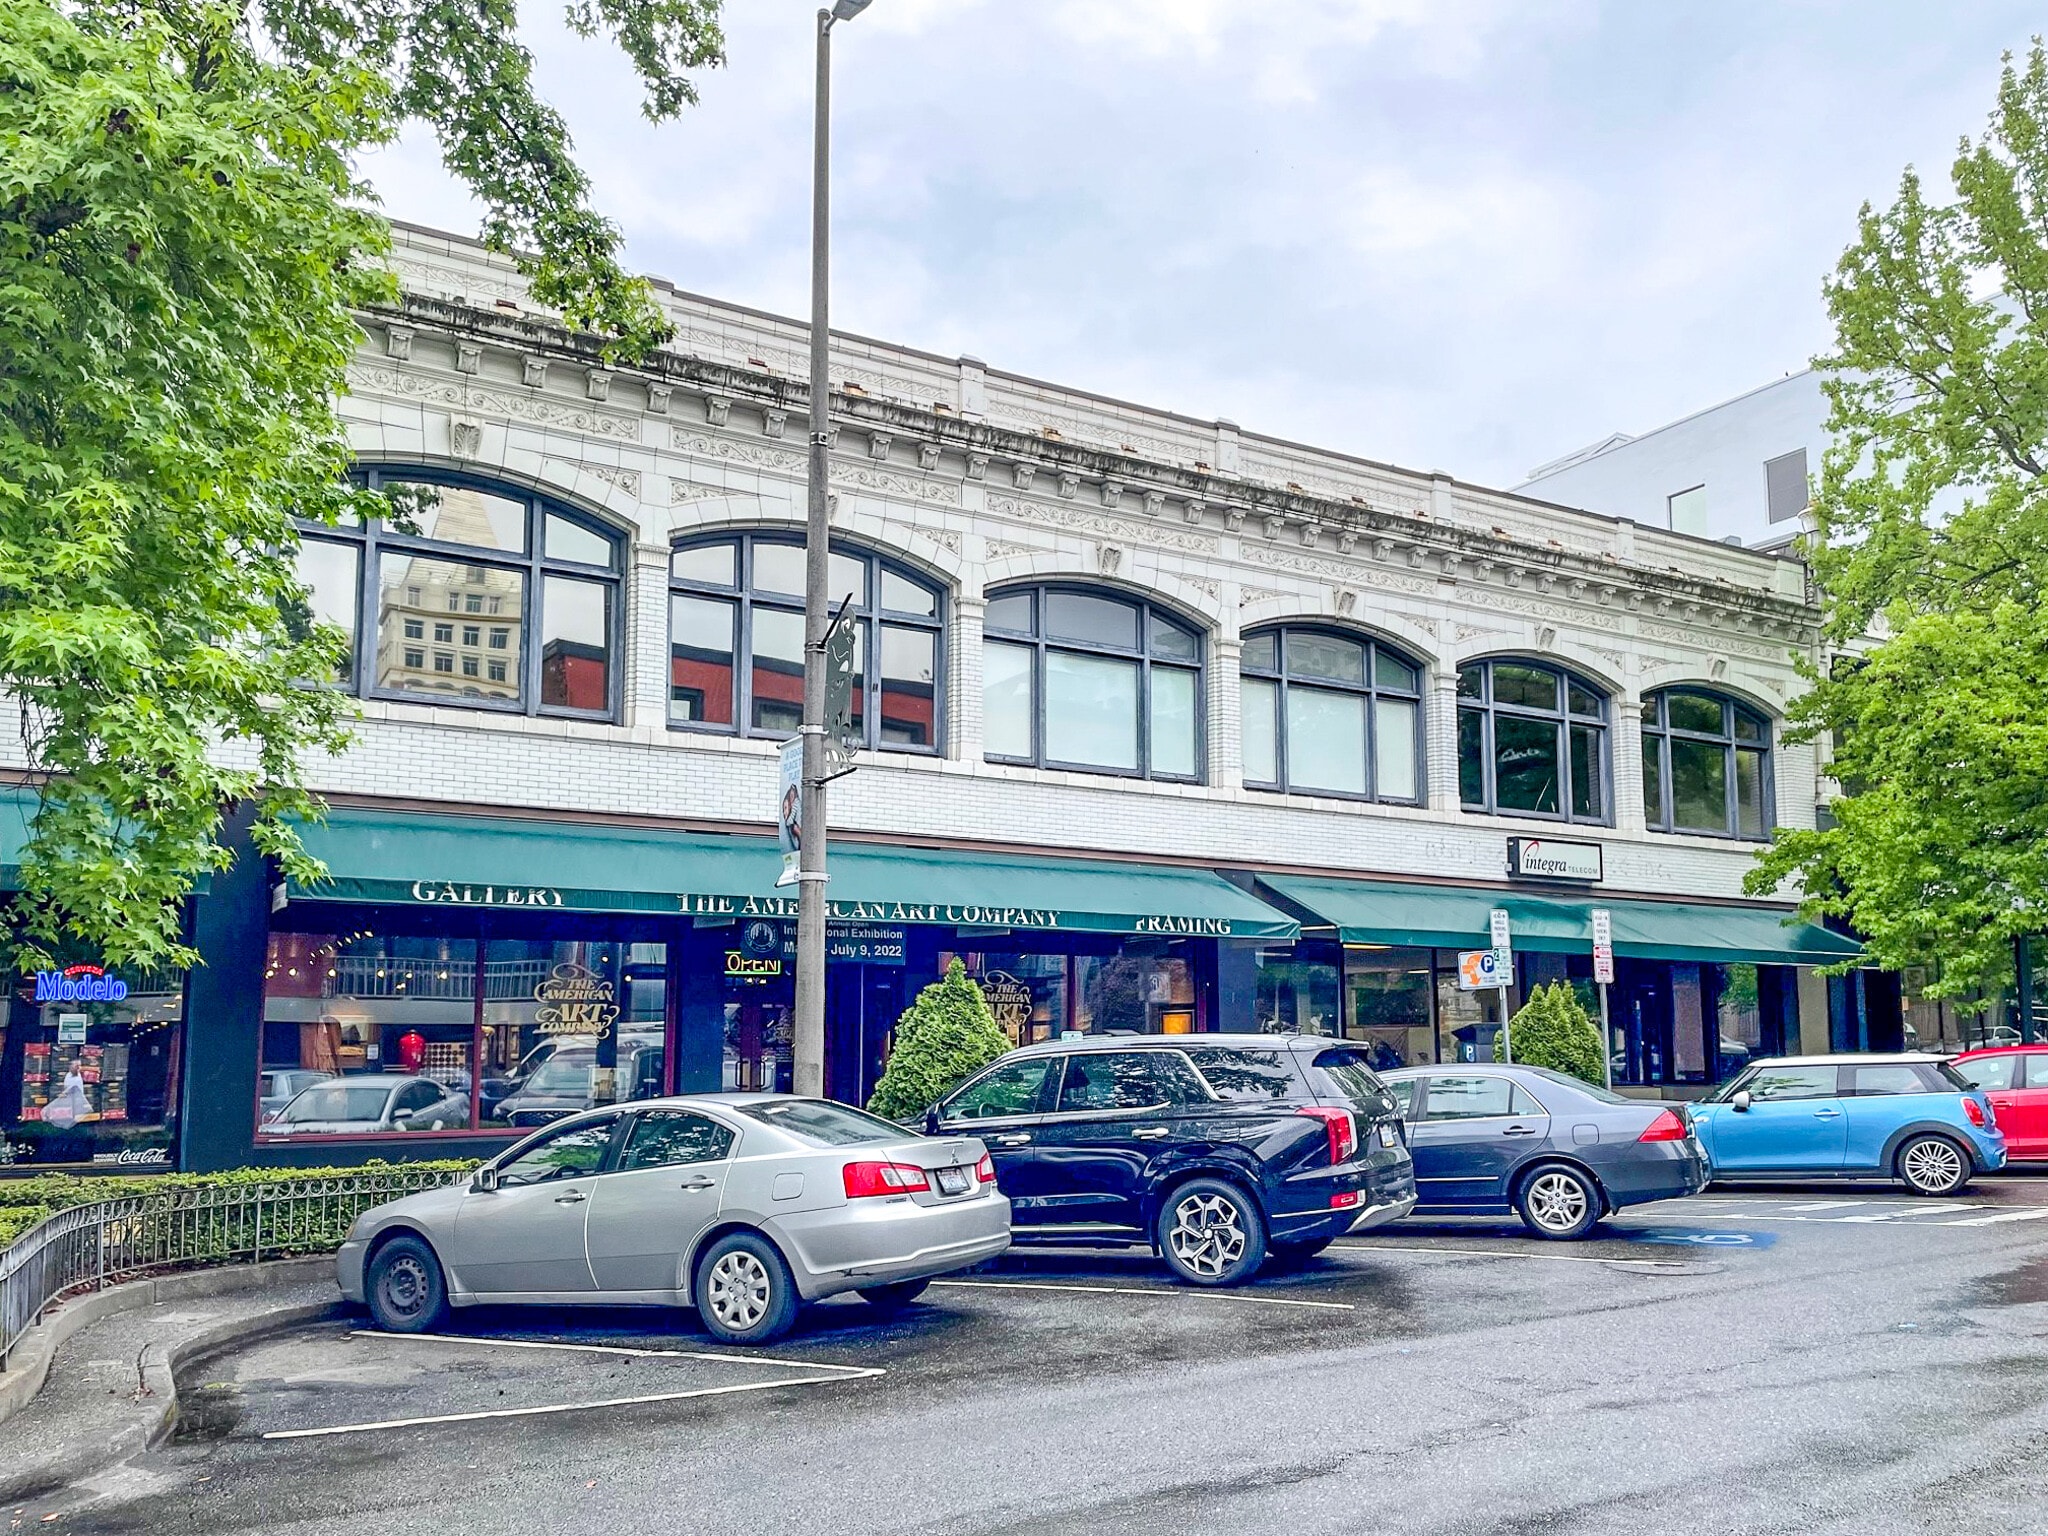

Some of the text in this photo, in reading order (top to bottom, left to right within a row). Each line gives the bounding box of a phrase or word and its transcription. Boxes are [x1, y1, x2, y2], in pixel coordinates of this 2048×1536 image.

[1525, 854, 1567, 875] integra
[1568, 866, 1598, 874] TELECOM
[412, 880, 565, 906] GALLERY
[676, 893, 1061, 927] THE AMEICAN ART COMPANY
[851, 928, 903, 939] Exhibition
[831, 944, 857, 958] July
[860, 945, 871, 958] 9,
[874, 945, 902, 957] 2022
[64, 964, 104, 977] CERVEZA
[727, 954, 777, 972] OPEN
[1483, 956, 1493, 972] P
[36, 971, 127, 1001] Modelo
[567, 979, 597, 990] THE
[538, 985, 614, 1002] AMERICAN
[985, 990, 1031, 1004] MERICAN
[545, 1003, 612, 1022] ART
